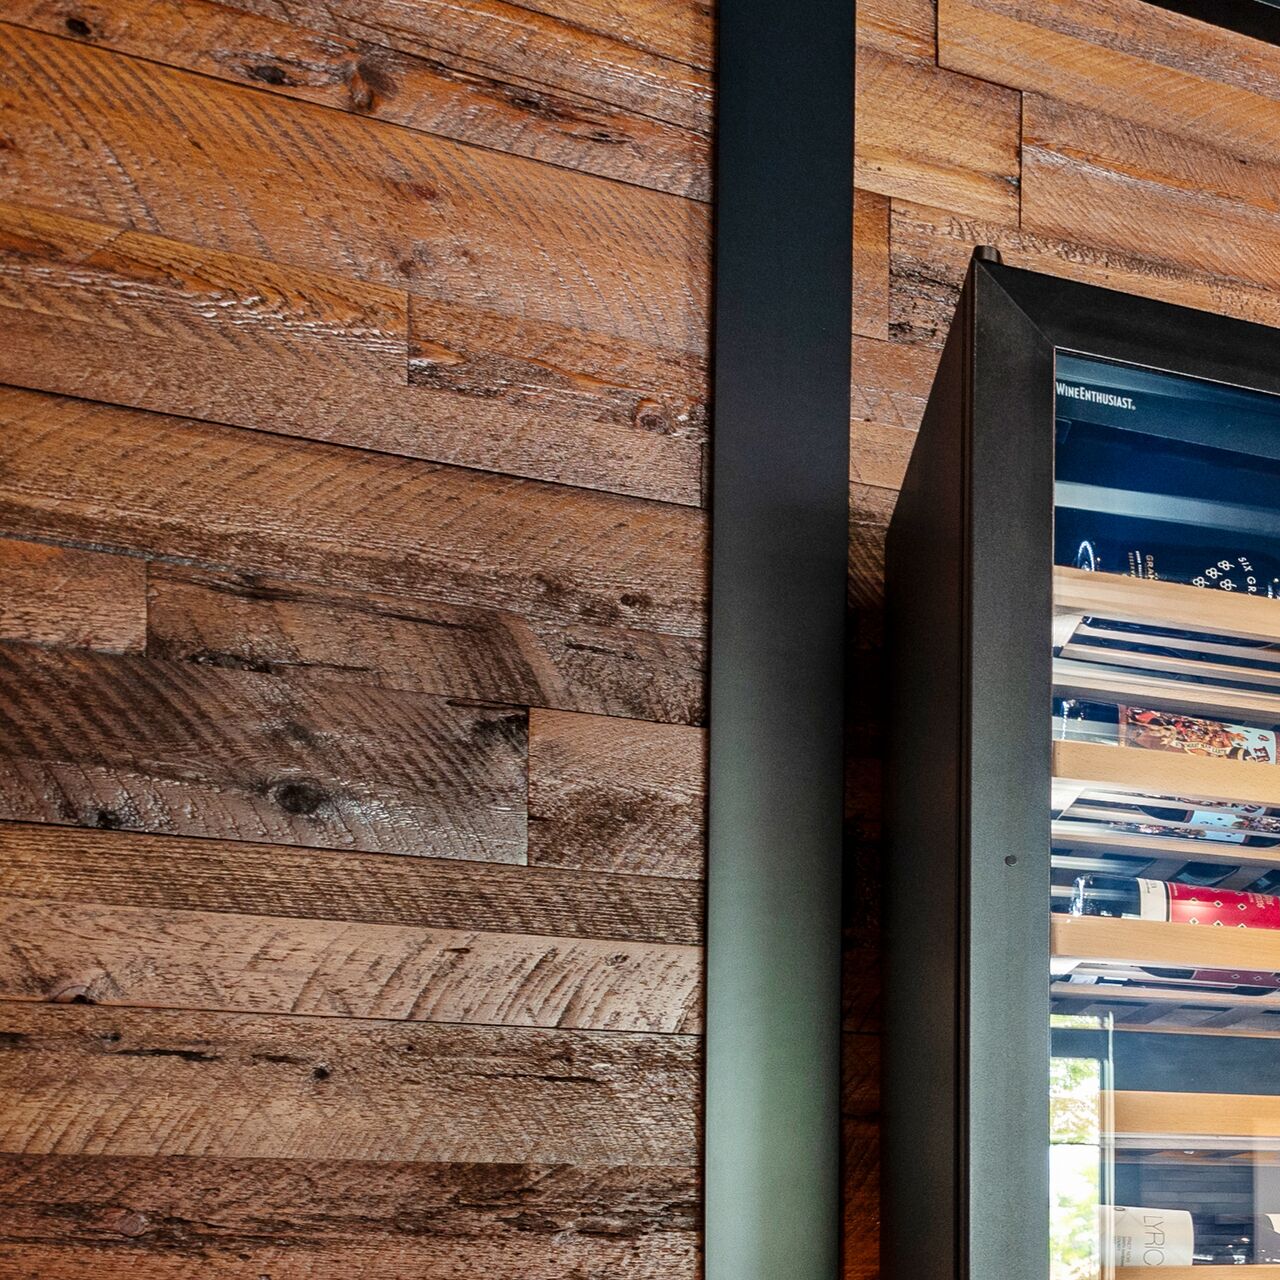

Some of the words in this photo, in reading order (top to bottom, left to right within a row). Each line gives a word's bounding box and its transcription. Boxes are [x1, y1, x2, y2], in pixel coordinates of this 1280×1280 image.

[1237, 556, 1254, 573] SIX
[1245, 575, 1258, 596] GR
[1142, 1215, 1166, 1267] LYRIC
